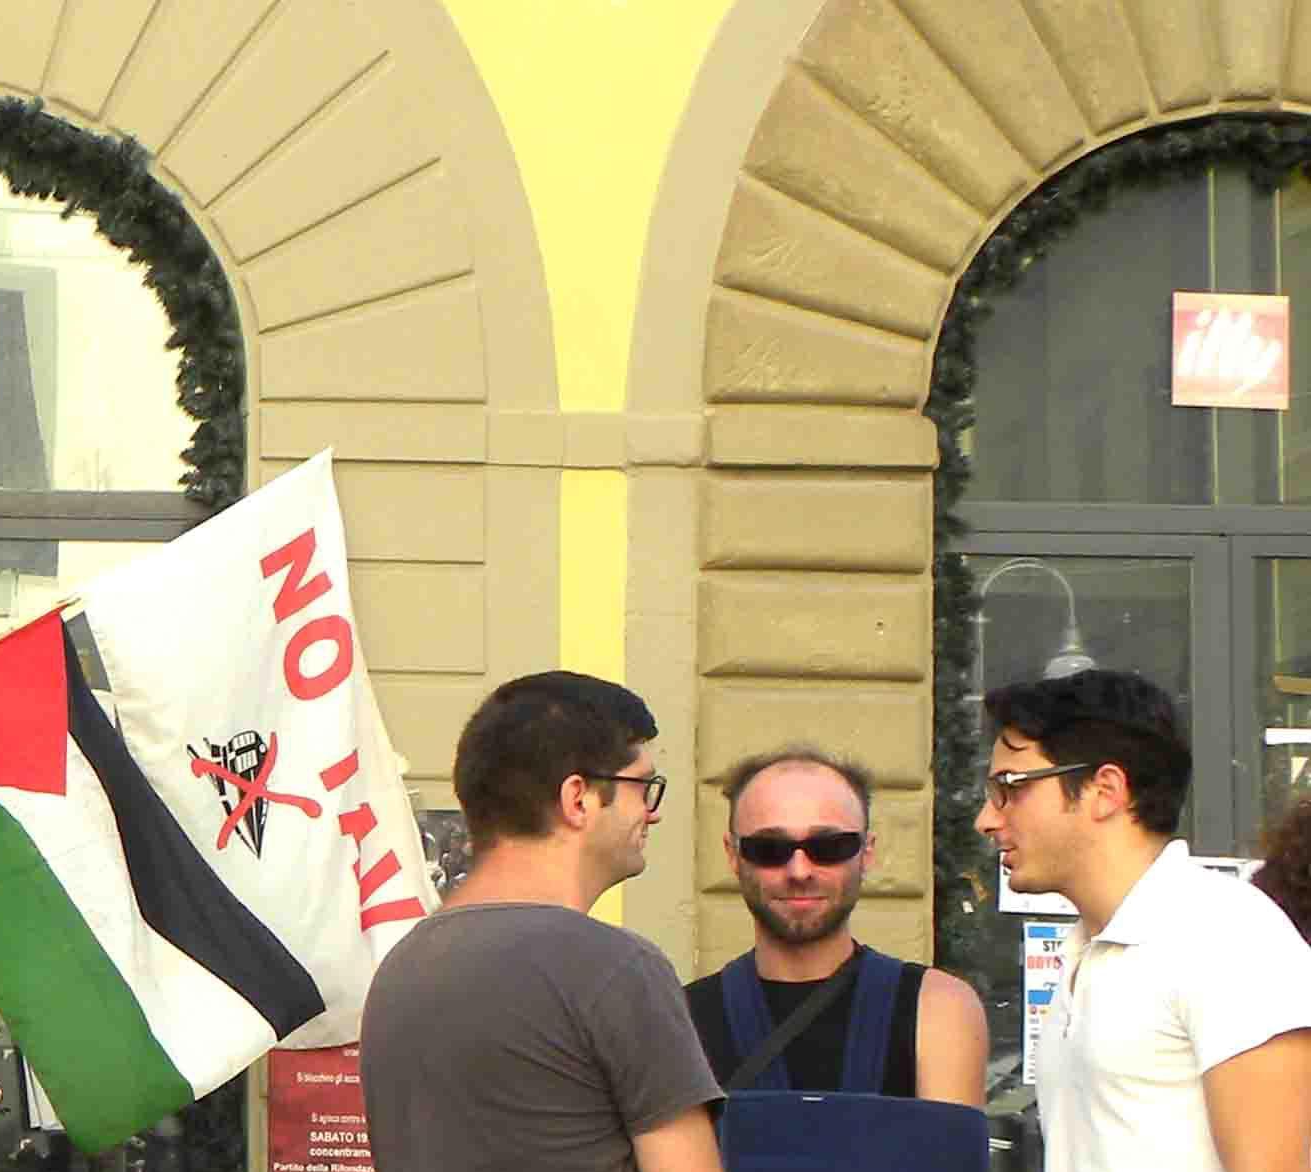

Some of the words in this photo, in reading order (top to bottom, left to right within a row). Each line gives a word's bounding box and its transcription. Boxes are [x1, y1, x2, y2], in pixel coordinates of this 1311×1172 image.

[1176, 304, 1283, 397] illy
[259, 527, 353, 700] NO
[309, 1132, 354, 1143] SABATO
[273, 1162, 305, 1172] Partito
[306, 1162, 329, 1172] della
